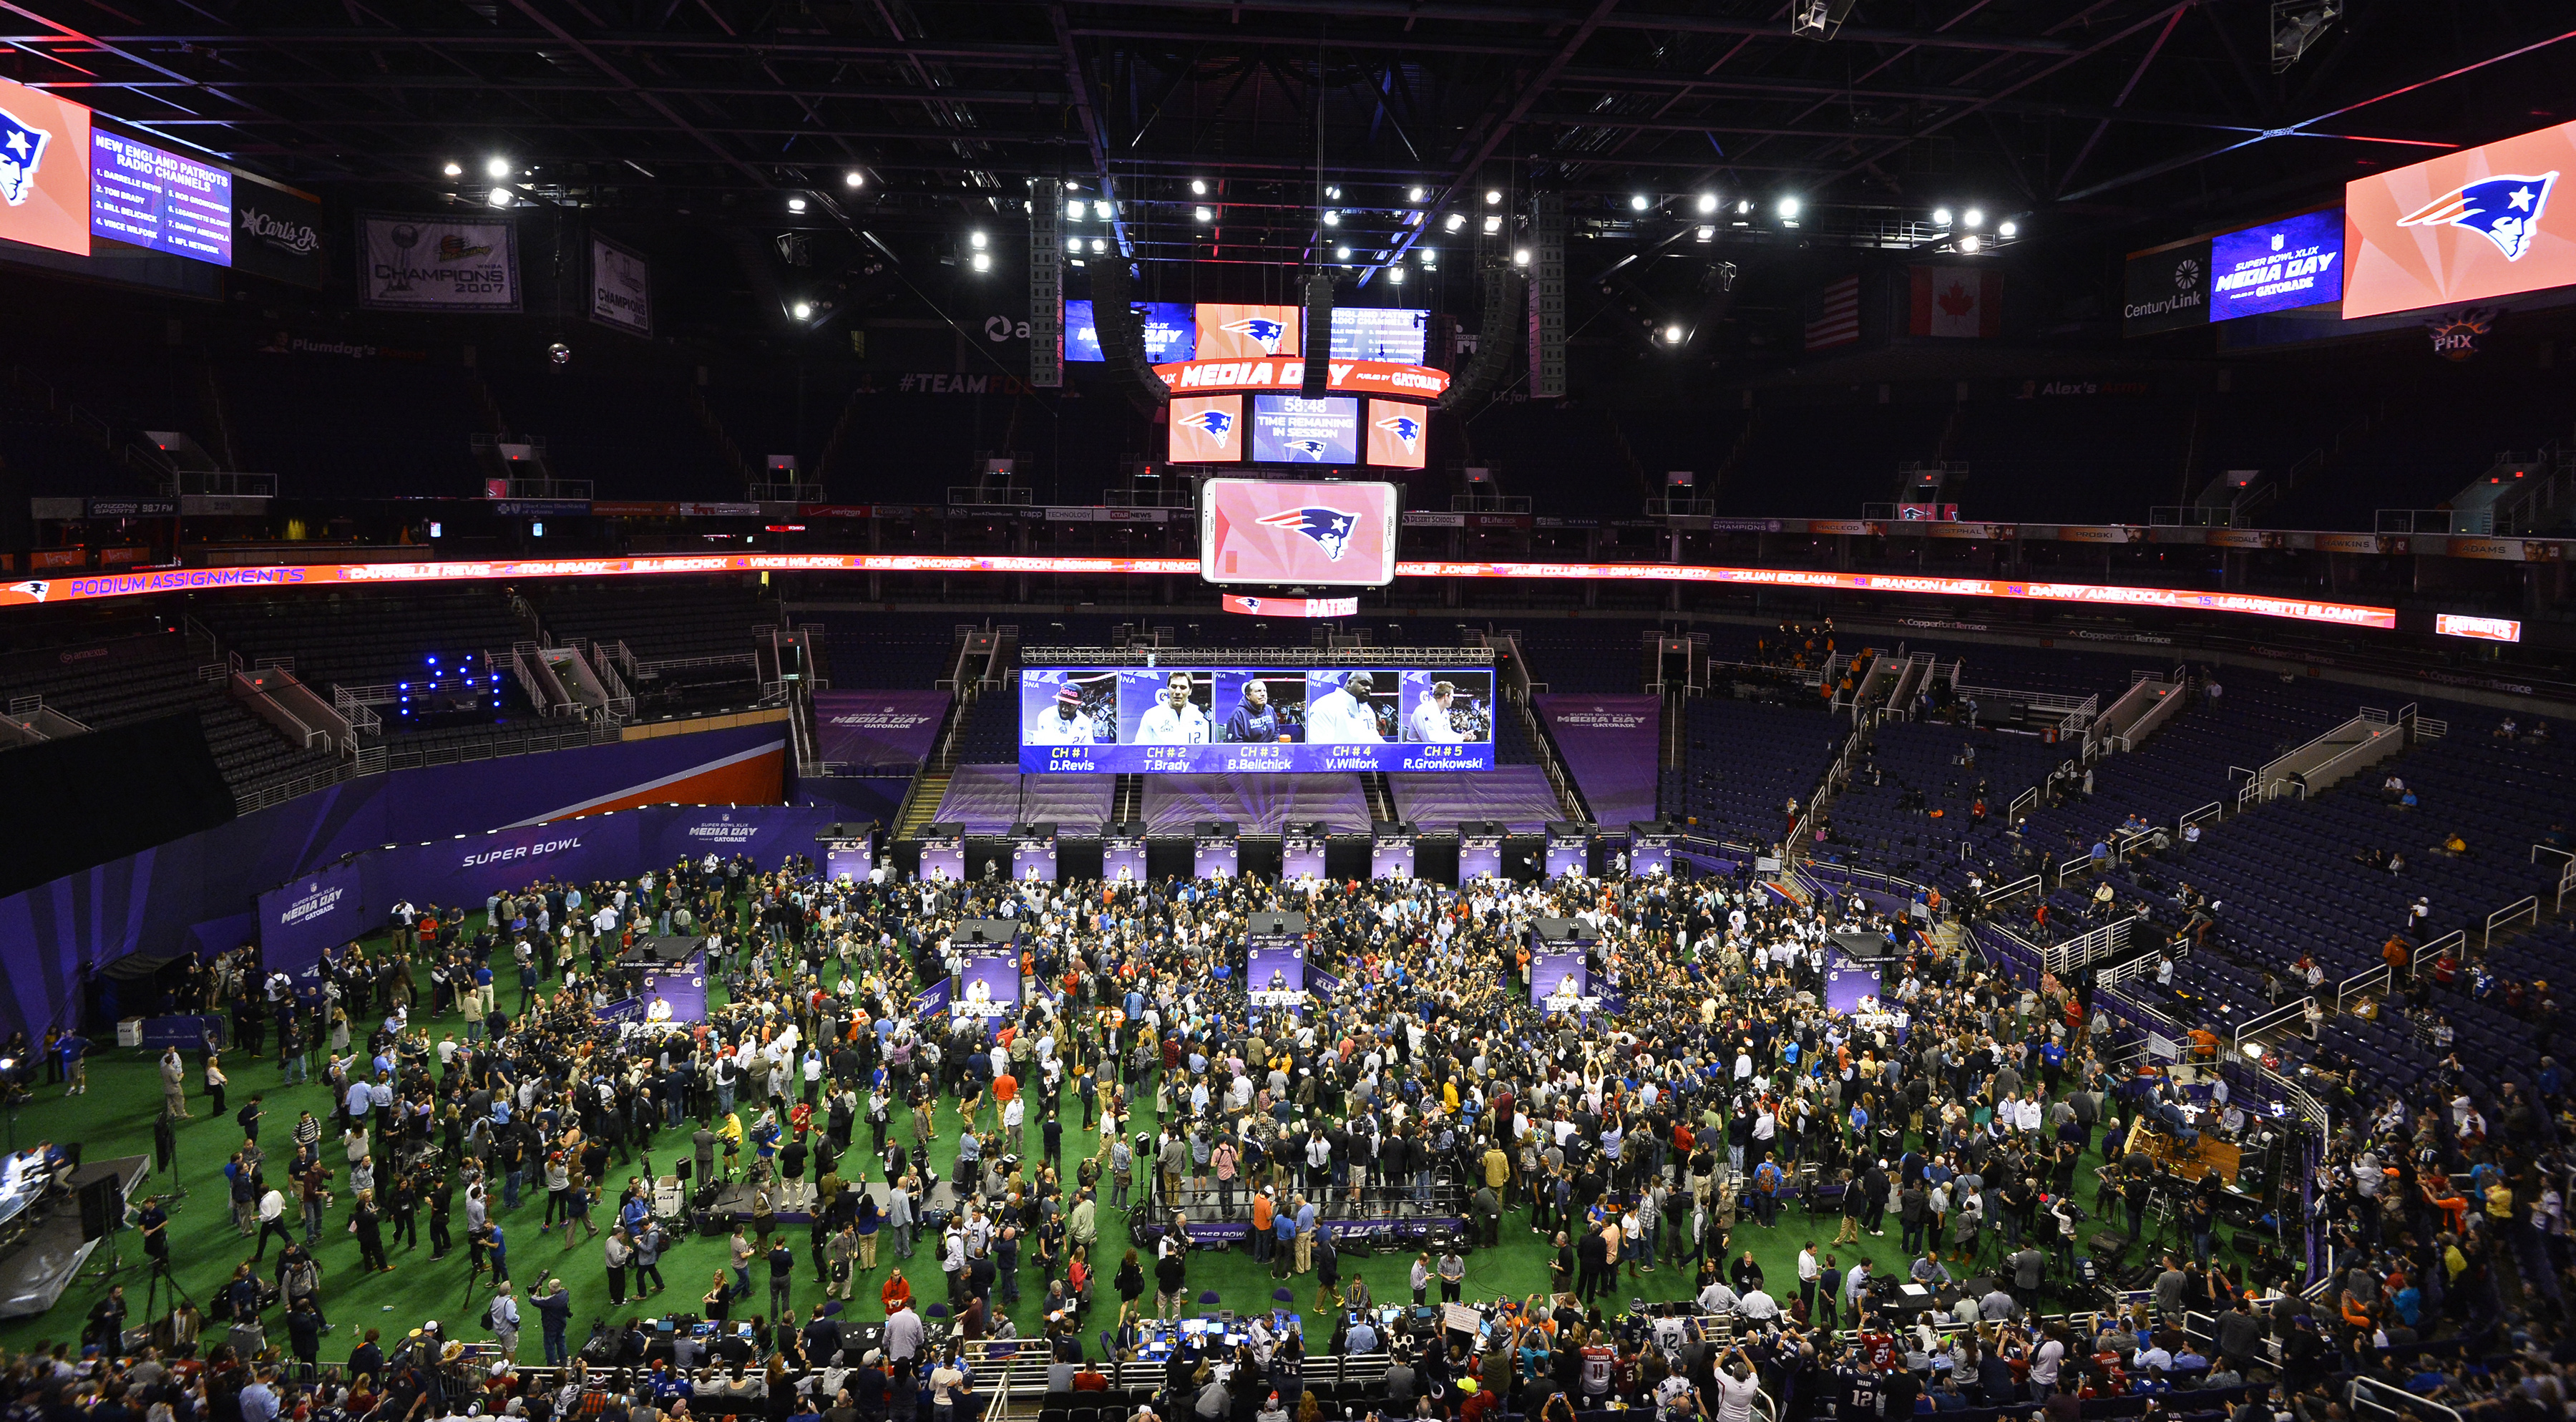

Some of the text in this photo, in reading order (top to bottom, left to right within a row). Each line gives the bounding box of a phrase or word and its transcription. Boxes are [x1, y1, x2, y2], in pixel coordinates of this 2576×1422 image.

[96, 135, 228, 187] NEW ENGLAND PATRIOTS
[104, 170, 162, 193] DARRELLE REVIS
[117, 154, 211, 193] RADIO CHANNELS
[104, 187, 145, 204] TOM BRADY
[104, 203, 120, 213] BILL
[104, 219, 157, 239] VINCE WILFORK
[175, 222, 196, 234] DANNY
[255, 213, 296, 240] Carl's
[175, 237, 220, 254] NFL NETWORK
[2234, 245, 2319, 273] SUPER BOWL XLIX
[375, 264, 504, 283] CHAMPIONS
[2215, 252, 2337, 292] MEDIA DAY
[455, 284, 505, 293] 2007
[2255, 276, 2314, 298] GATORADE
[597, 288, 646, 316] CHAMPIONS
[2124, 291, 2201, 319] CenturyLink
[293, 339, 376, 358] Plumdog's
[2434, 334, 2472, 352] PHX
[1181, 362, 1273, 387] MEDIA
[1392, 372, 1442, 391] GATORADE
[2042, 380, 2097, 396] Alex's
[1284, 399, 1327, 413] 58:48
[1257, 417, 1354, 429] TIME REMAINING
[1273, 428, 1338, 438] IN SESSION
[142, 504, 173, 513] 98.7 FM
[2005, 528, 2013, 537] 44
[2322, 540, 2405, 550] HAWKINS 42
[2462, 545, 2506, 554] ADAMS
[71, 577, 145, 598] PODIUM
[150, 568, 305, 590] ASSIGNMENTS
[351, 565, 440, 579] DARRELLE
[442, 564, 491, 577] REVIS
[520, 563, 553, 574] TOM
[555, 562, 607, 573] BRADY
[633, 560, 662, 570] BILL
[750, 557, 787, 568] VINCE
[789, 557, 844, 568] WILFORK
[865, 557, 891, 568] ROB
[893, 557, 972, 569] GRONKOWSKI
[993, 559, 1051, 570] BRANDON
[1134, 561, 1159, 570] ROB
[1442, 565, 1480, 575] JONES
[1733, 571, 1775, 582] JULIAN
[1777, 573, 1837, 585] EDELMAN
[1871, 578, 1938, 591] BRANDON
[1941, 580, 1993, 594] LAFELL
[2028, 586, 2085, 600] DANNY
[2087, 588, 2176, 604] AMENDOLA
[2197, 595, 2215, 605] 15.
[2219, 597, 2306, 615] LEGARRETTE
[2308, 605, 2367, 622] BLOUNT
[2445, 616, 2512, 639] PATRIOTS
[1052, 747, 1088, 759] CH 1
[1147, 747, 1186, 757] CH 2
[1240, 746, 1279, 756] CH 3
[1333, 746, 1371, 756] CH # 4
[1424, 746, 1463, 756] CH # 5
[1050, 760, 1095, 771] D.Revis
[1144, 759, 1190, 772] T.Brady
[1228, 759, 1292, 769] B.Belichick
[1326, 758, 1379, 769] V.Wilfork
[1403, 758, 1483, 769] R.Gronkowski
[689, 827, 758, 836] MEDIA DAY
[462, 837, 581, 867] SUPER BOWL
[281, 888, 343, 924] MEDIA DAY
[305, 903, 334, 920] GATORADE
[1662, 1333, 1678, 1349] 12
[1593, 1363, 1604, 1379] 11
[1626, 1370, 1634, 1382] 5
[1852, 1390, 1873, 1407] 12
